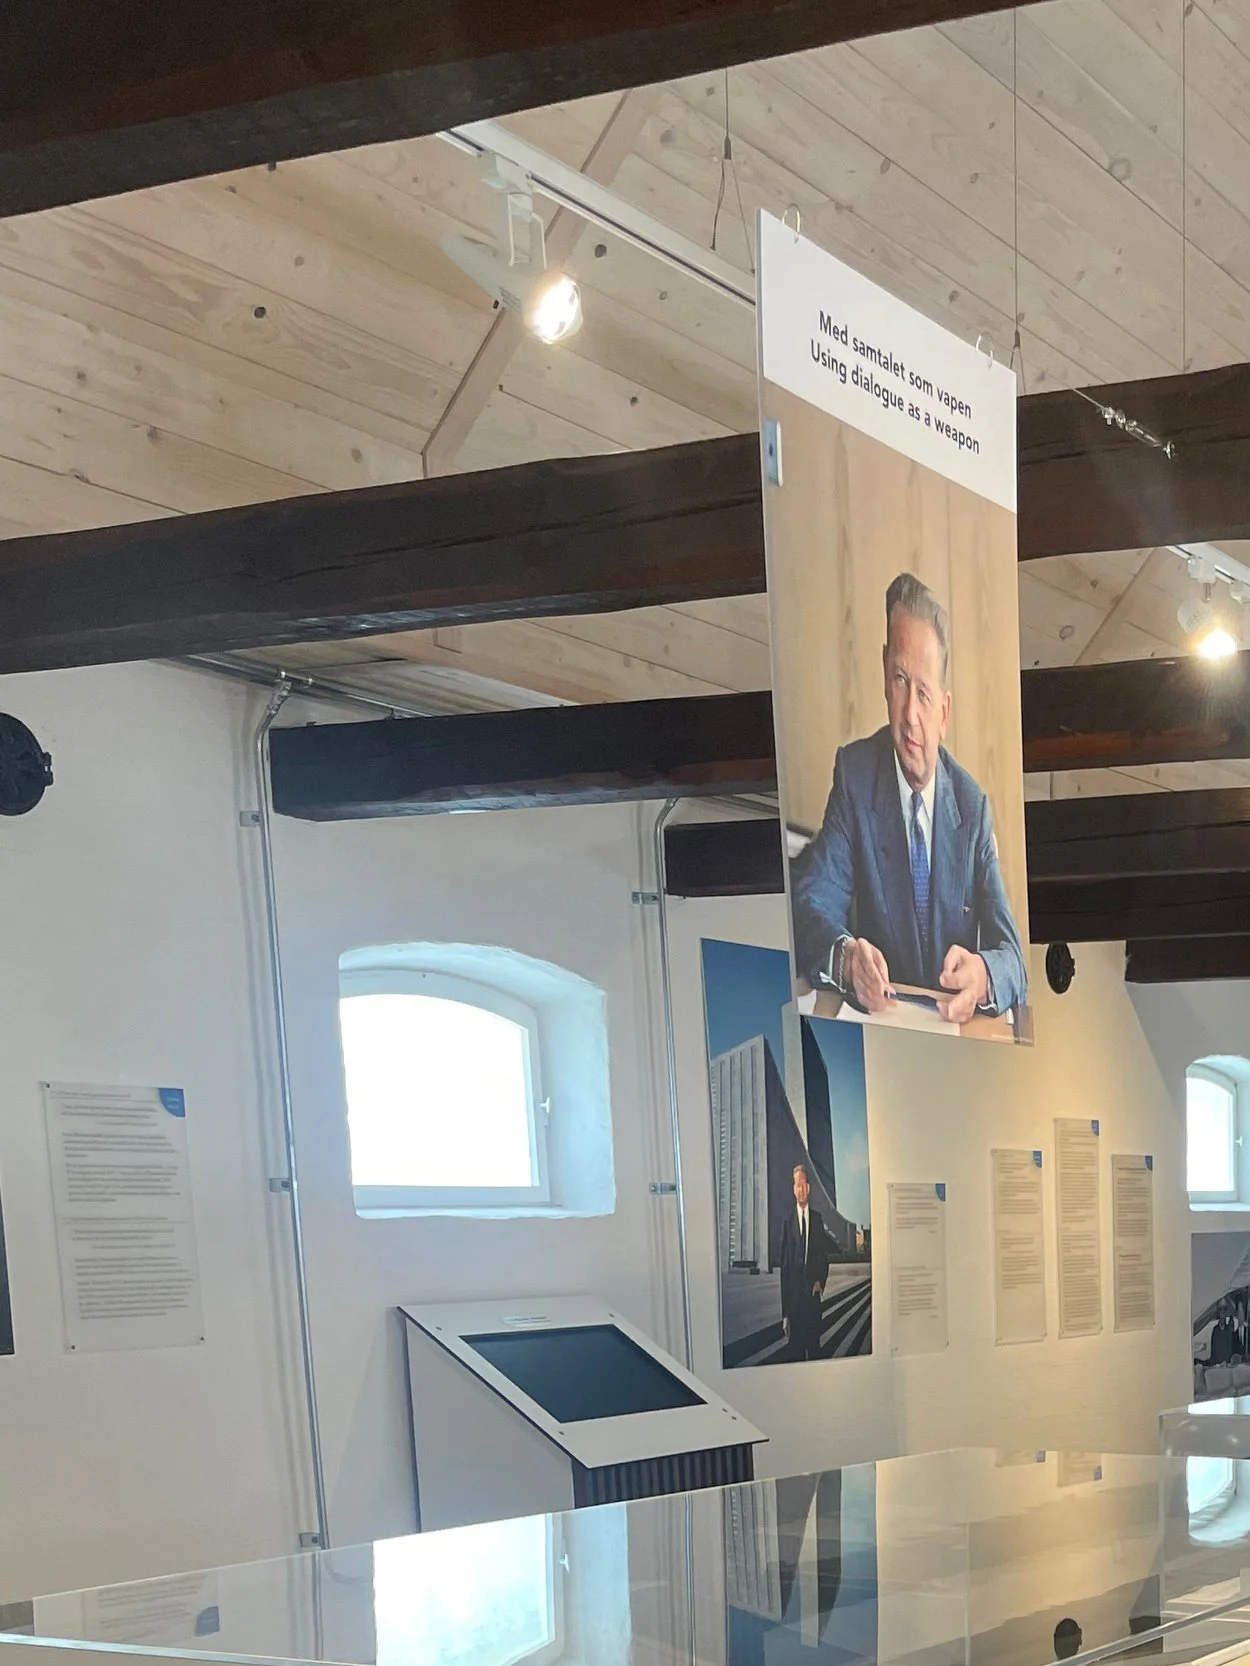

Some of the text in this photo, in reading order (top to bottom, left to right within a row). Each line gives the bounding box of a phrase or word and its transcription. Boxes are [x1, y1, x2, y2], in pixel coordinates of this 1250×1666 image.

[811, 339, 980, 454] Using dialogue as a weapon
[819, 310, 972, 420] Med samtalet som vapen
